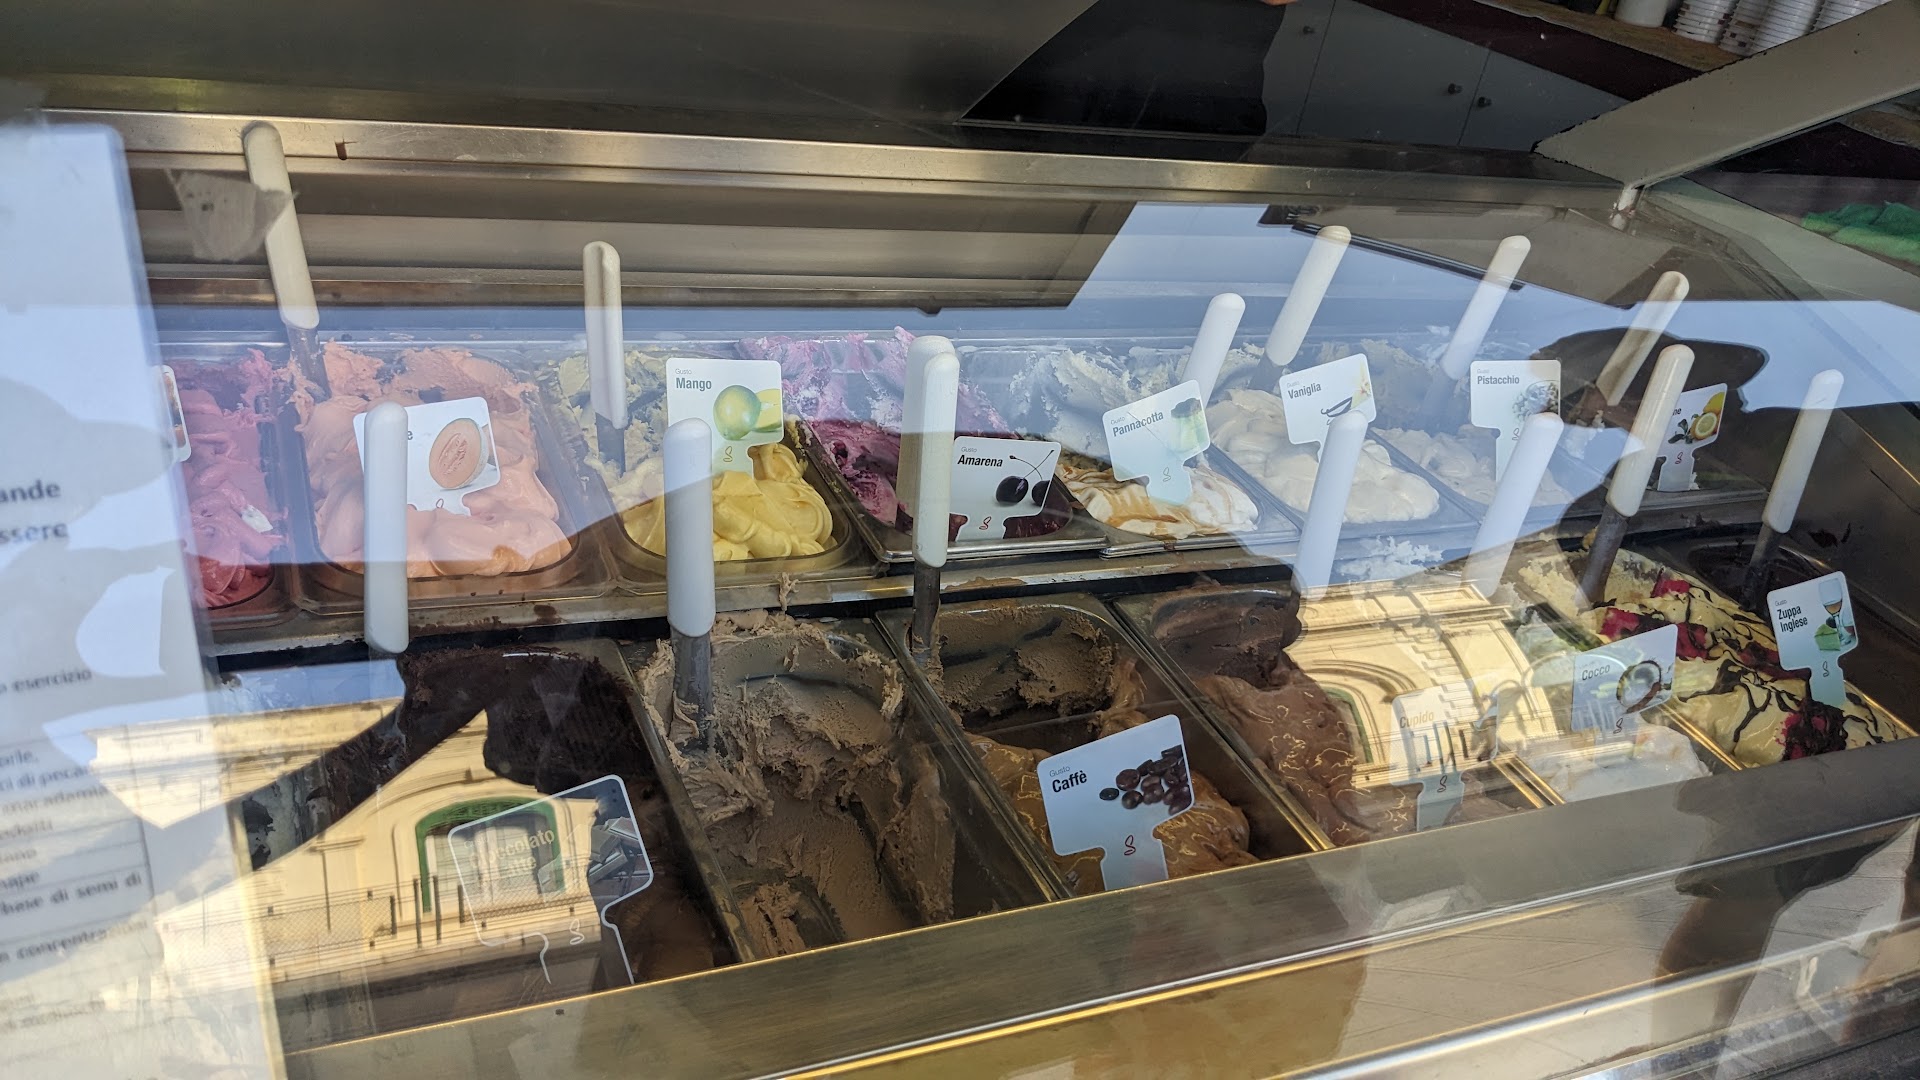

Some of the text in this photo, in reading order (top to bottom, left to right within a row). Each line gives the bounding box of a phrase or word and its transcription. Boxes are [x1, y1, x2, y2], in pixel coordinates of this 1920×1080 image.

[675, 377, 712, 392] Mango
[1477, 375, 1520, 385] Pistacchio
[1287, 382, 1322, 399] Vaniglia
[1112, 411, 1164, 437] Pannacotta
[957, 454, 1003, 468] Amarena
[1777, 605, 1802, 620] Zuppa
[1780, 616, 1808, 633] Inglese
[1581, 664, 1611, 681] Cocco
[1399, 709, 1435, 729] Cupido
[1049, 765, 1071, 777] Gusto
[1052, 770, 1088, 793] Caffè
[124, 871, 142, 888] di
